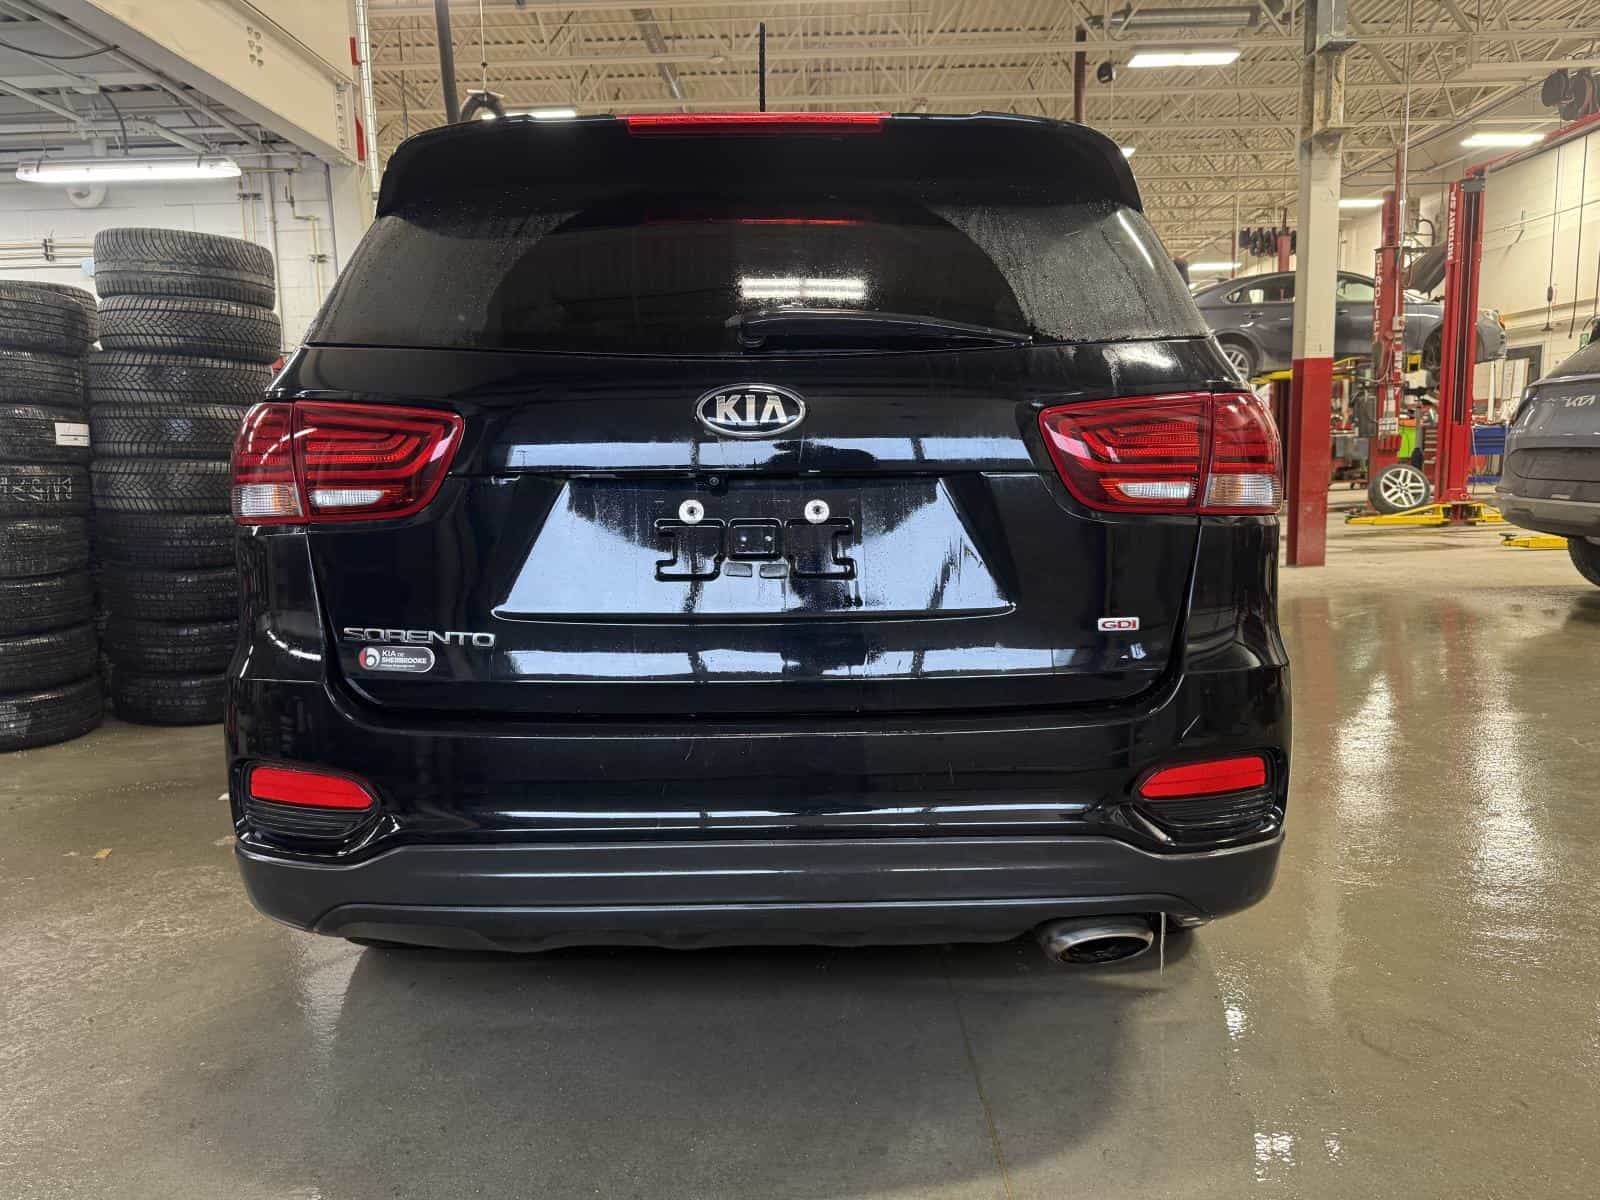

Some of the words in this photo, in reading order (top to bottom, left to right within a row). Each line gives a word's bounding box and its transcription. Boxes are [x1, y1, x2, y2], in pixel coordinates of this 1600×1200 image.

[715, 394, 788, 424] KIA
[1102, 619, 1137, 629] GDI
[343, 627, 496, 648] SORENTO
[382, 649, 396, 657] KIA
